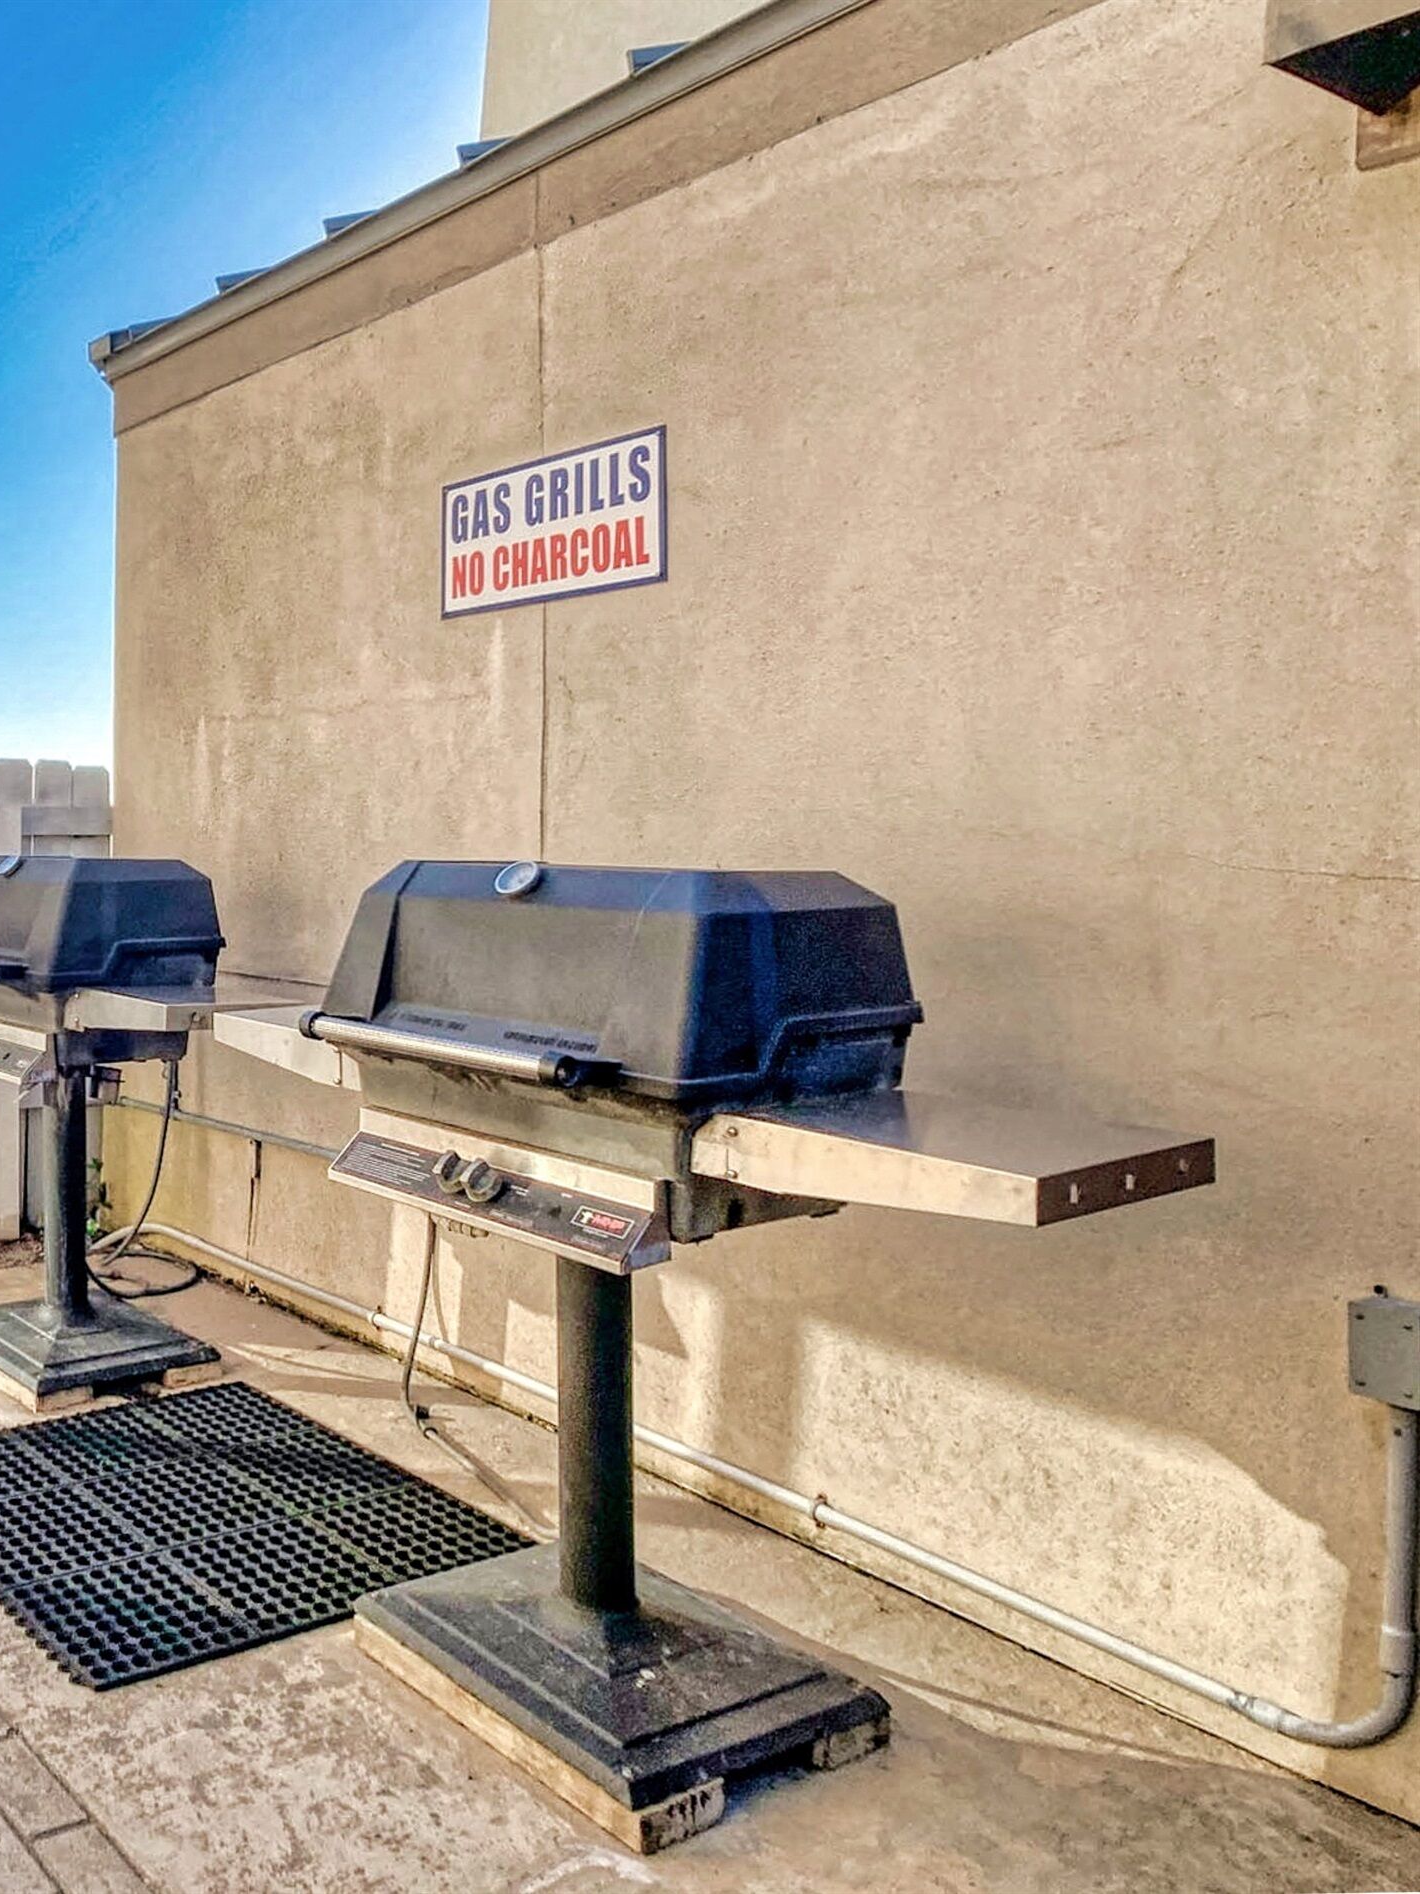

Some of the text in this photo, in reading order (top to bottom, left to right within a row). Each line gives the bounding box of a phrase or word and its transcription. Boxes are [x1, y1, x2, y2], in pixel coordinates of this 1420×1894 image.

[451, 445, 651, 544] GAS GRILLS
[451, 516, 650, 599] NO CHARCOAL
